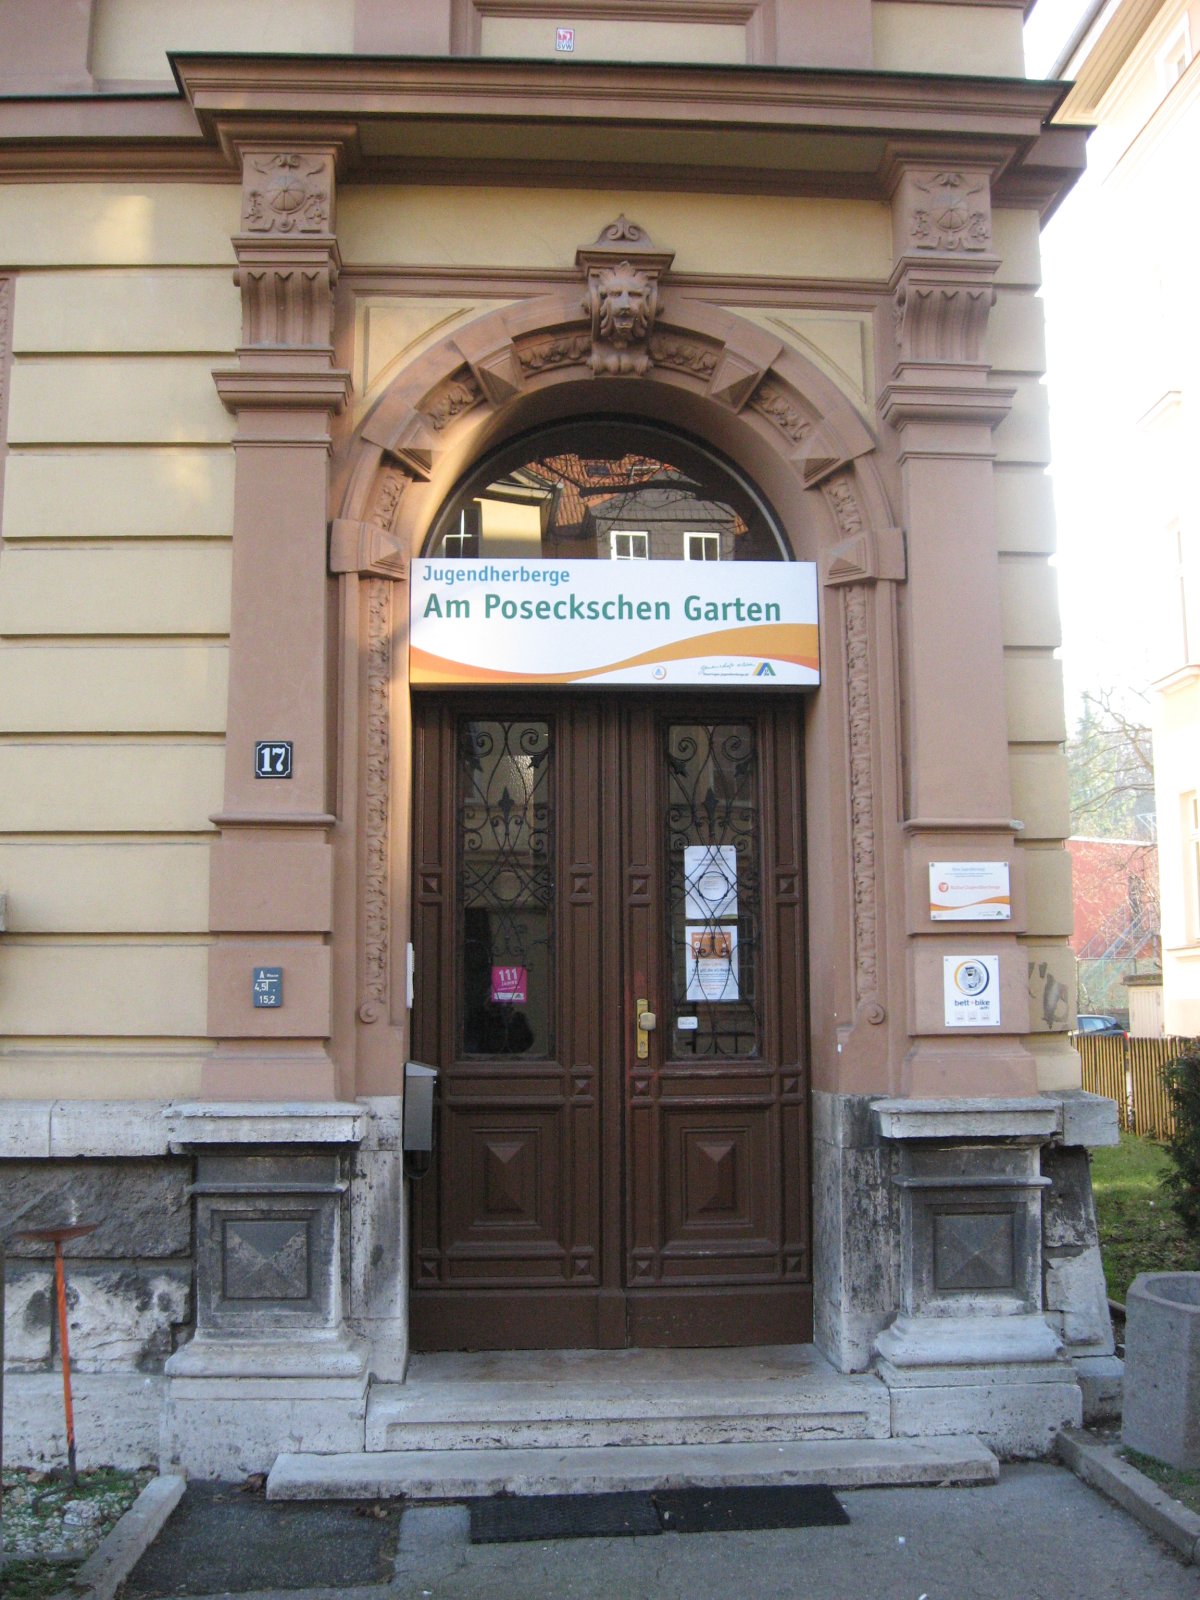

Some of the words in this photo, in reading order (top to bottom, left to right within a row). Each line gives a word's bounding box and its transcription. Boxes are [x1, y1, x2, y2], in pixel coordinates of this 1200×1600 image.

[423, 565, 570, 586] Jugendherberge
[423, 593, 470, 619] Am
[485, 593, 670, 620] Poseckschen
[684, 595, 781, 621] Garten
[261, 747, 286, 772] 17
[259, 995, 275, 1004] 15,2
